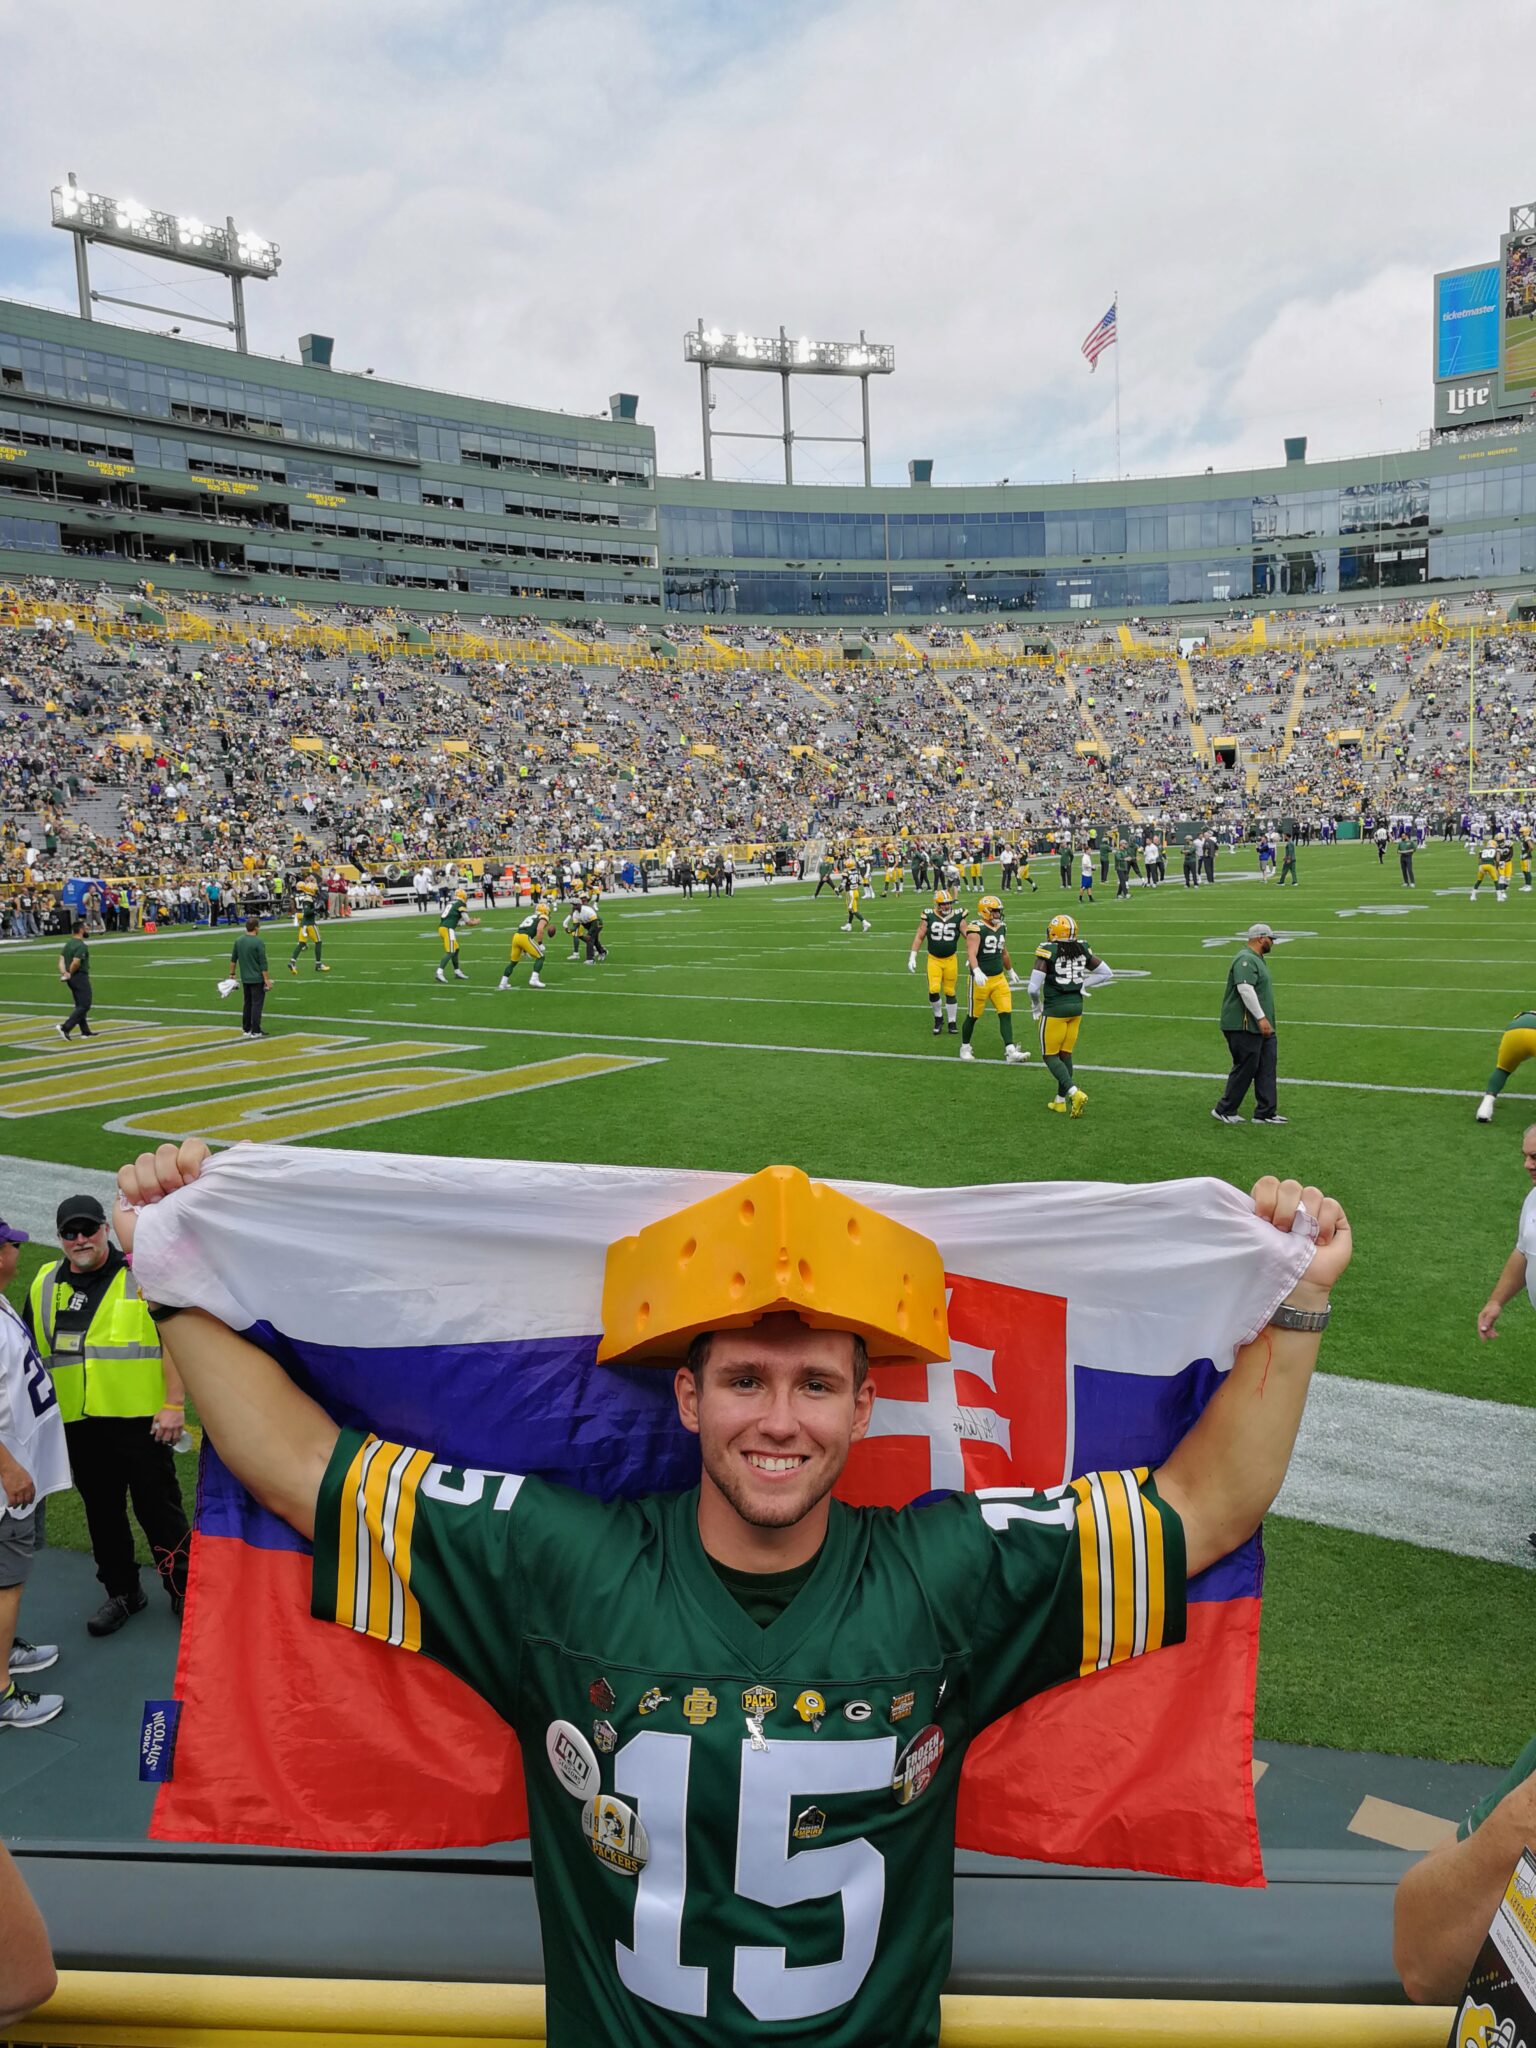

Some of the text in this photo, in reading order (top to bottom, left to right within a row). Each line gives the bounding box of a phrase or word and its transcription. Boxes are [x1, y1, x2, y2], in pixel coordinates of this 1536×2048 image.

[1442, 304, 1497, 322] ticketmaster
[1446, 387, 1490, 415] Lite
[930, 921, 957, 942] 95
[1054, 954, 1087, 985] 98
[745, 1694, 774, 1708] PACK
[141, 1723, 153, 1754] VODKA
[905, 1731, 940, 1768] FROZEN
[557, 1757, 581, 1785] SEASONS
[558, 1737, 587, 1779] 100
[904, 1746, 940, 1786] TUNDRA
[592, 1841, 639, 1873] PACKERS
[613, 1729, 898, 2022] 15
